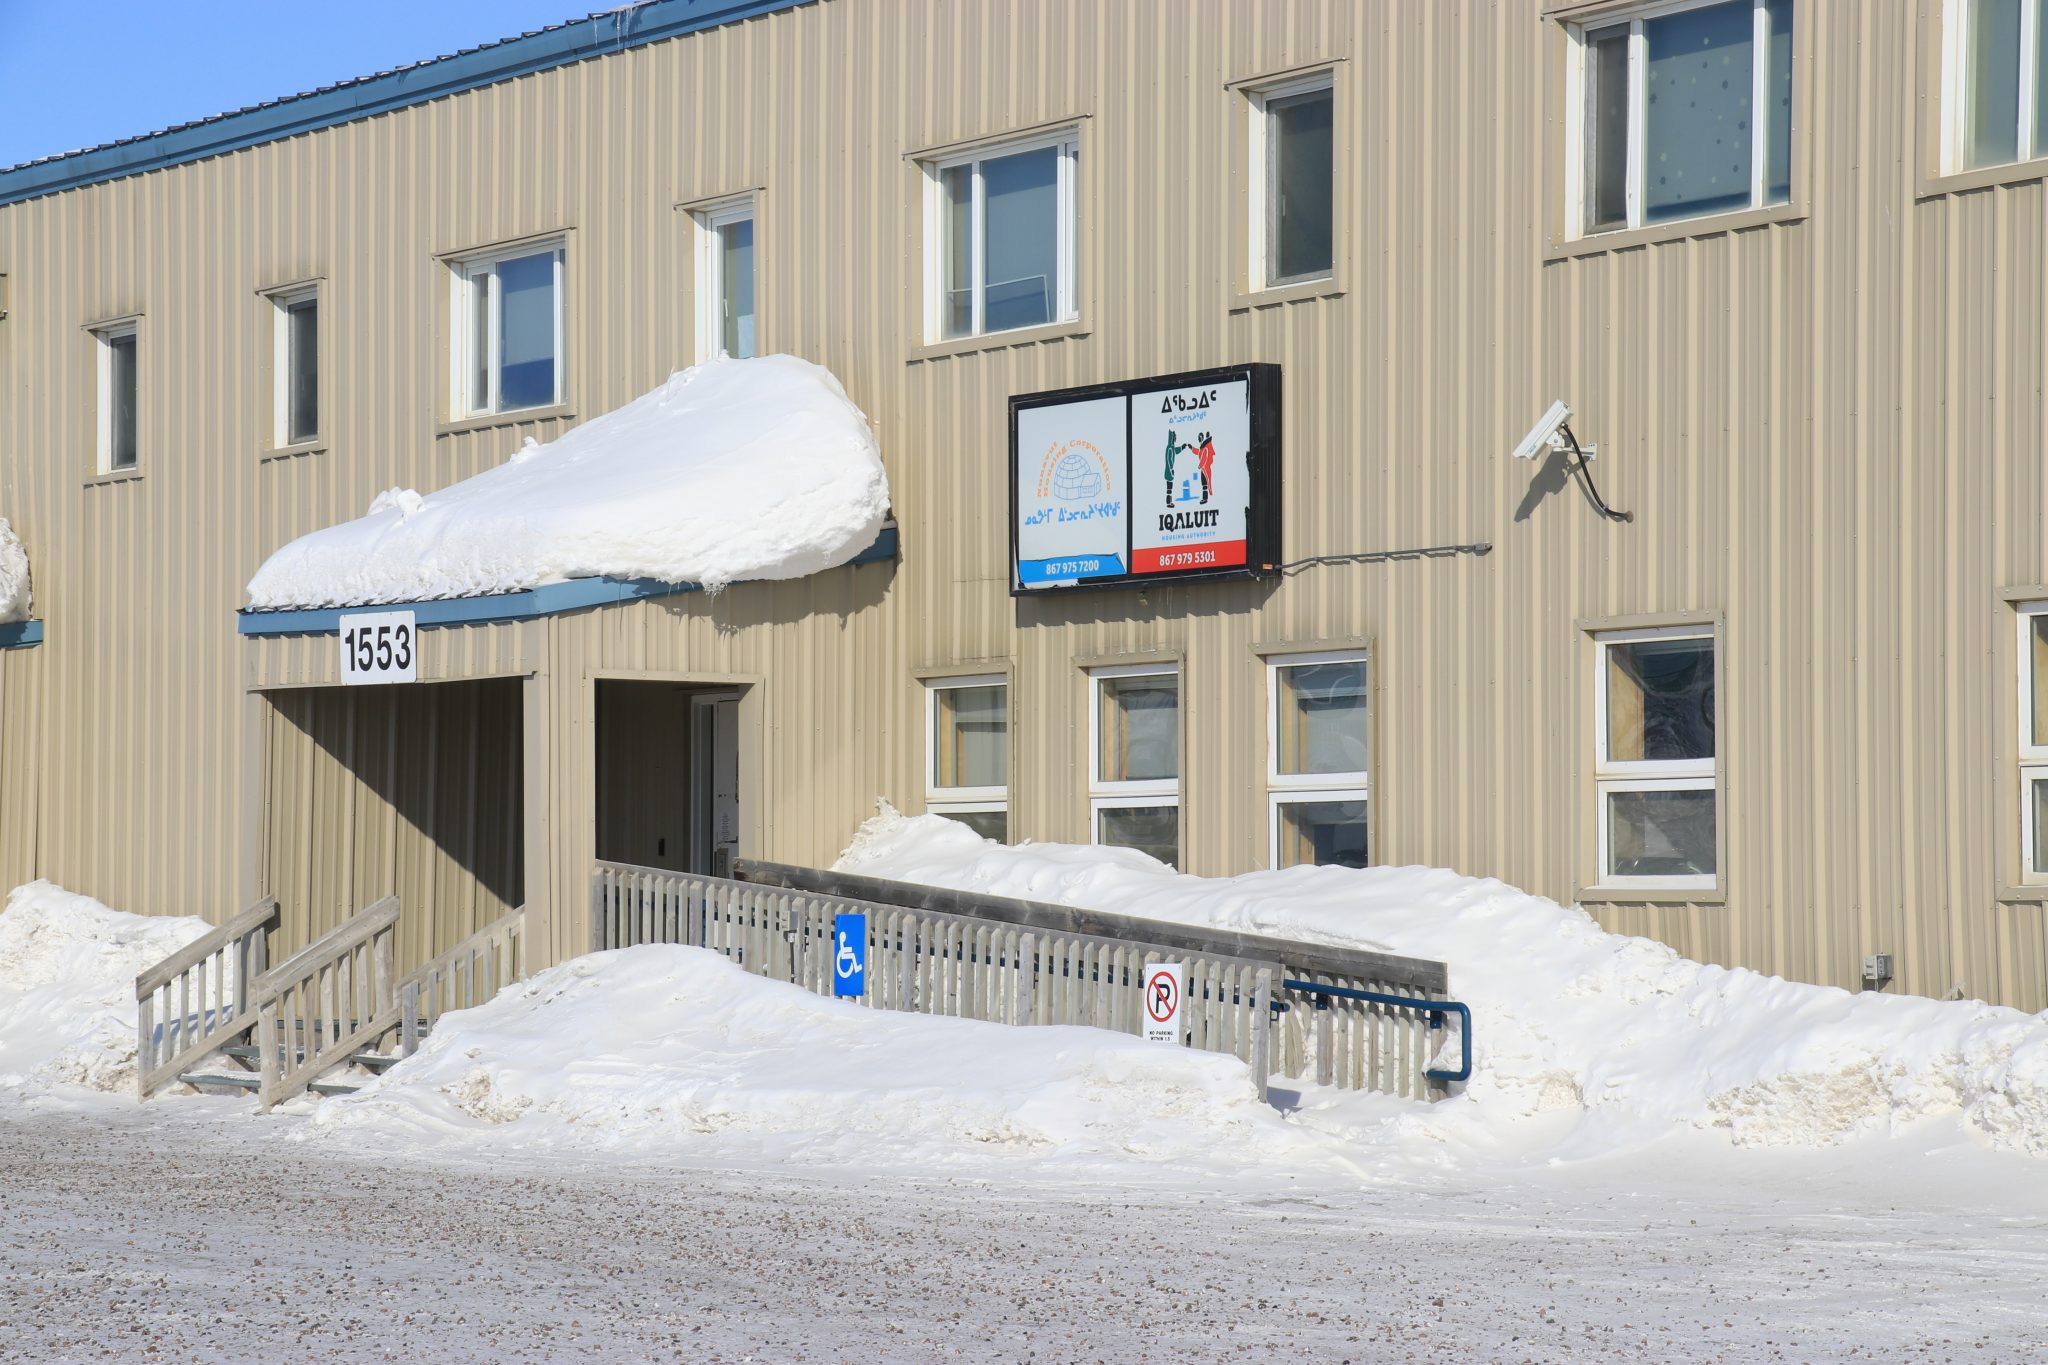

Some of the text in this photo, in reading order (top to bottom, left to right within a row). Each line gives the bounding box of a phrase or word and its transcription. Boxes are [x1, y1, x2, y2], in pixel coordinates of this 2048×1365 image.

[1069, 440, 1111, 491] Corporation
[1159, 509, 1219, 532] IQALUIT
[1161, 531, 1216, 541] HOUSING AUTHORITY
[1046, 559, 1099, 575] 867 975 7200
[1160, 550, 1216, 567] 867 979 5301
[345, 624, 411, 672] 1553
